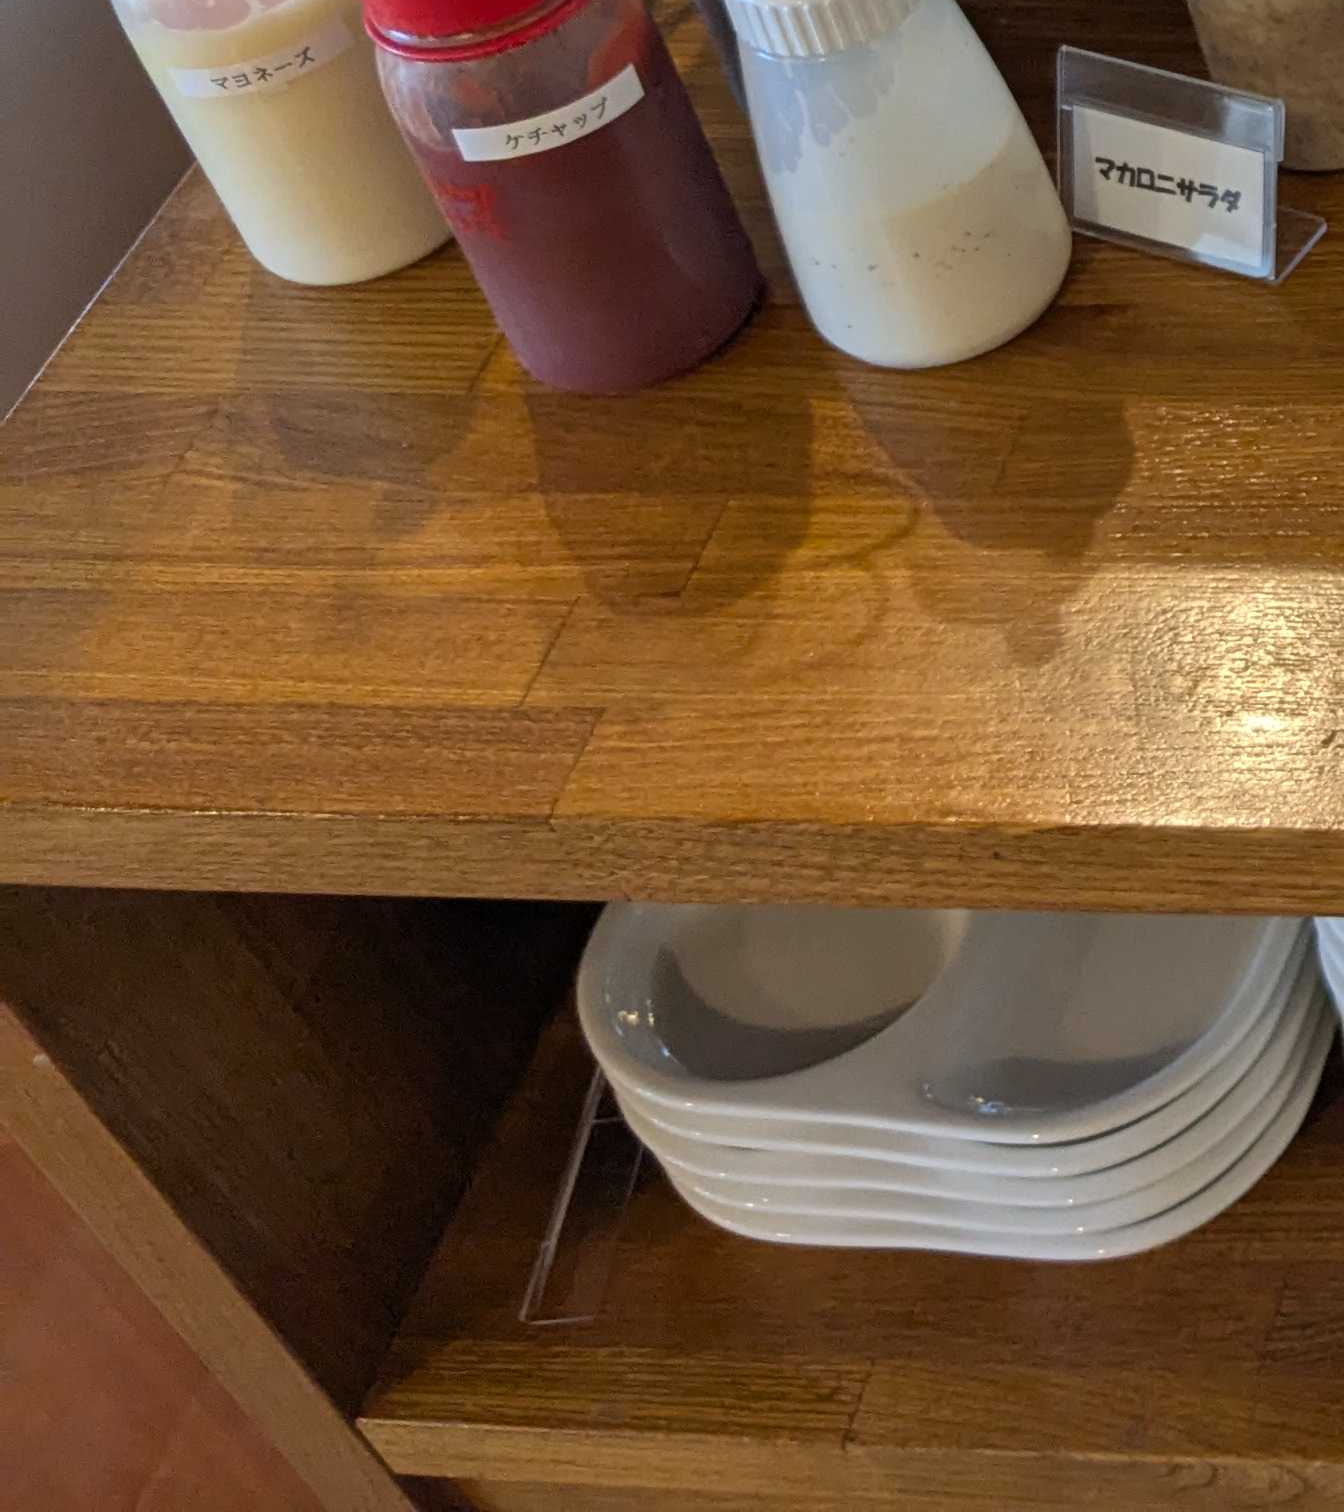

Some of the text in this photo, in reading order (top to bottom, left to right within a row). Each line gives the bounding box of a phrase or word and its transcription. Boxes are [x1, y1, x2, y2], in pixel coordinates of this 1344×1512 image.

[211, 46, 316, 90] マヨネーズ
[505, 96, 608, 150] ケチャップ
[1095, 156, 1242, 213] マカロニサラダ
